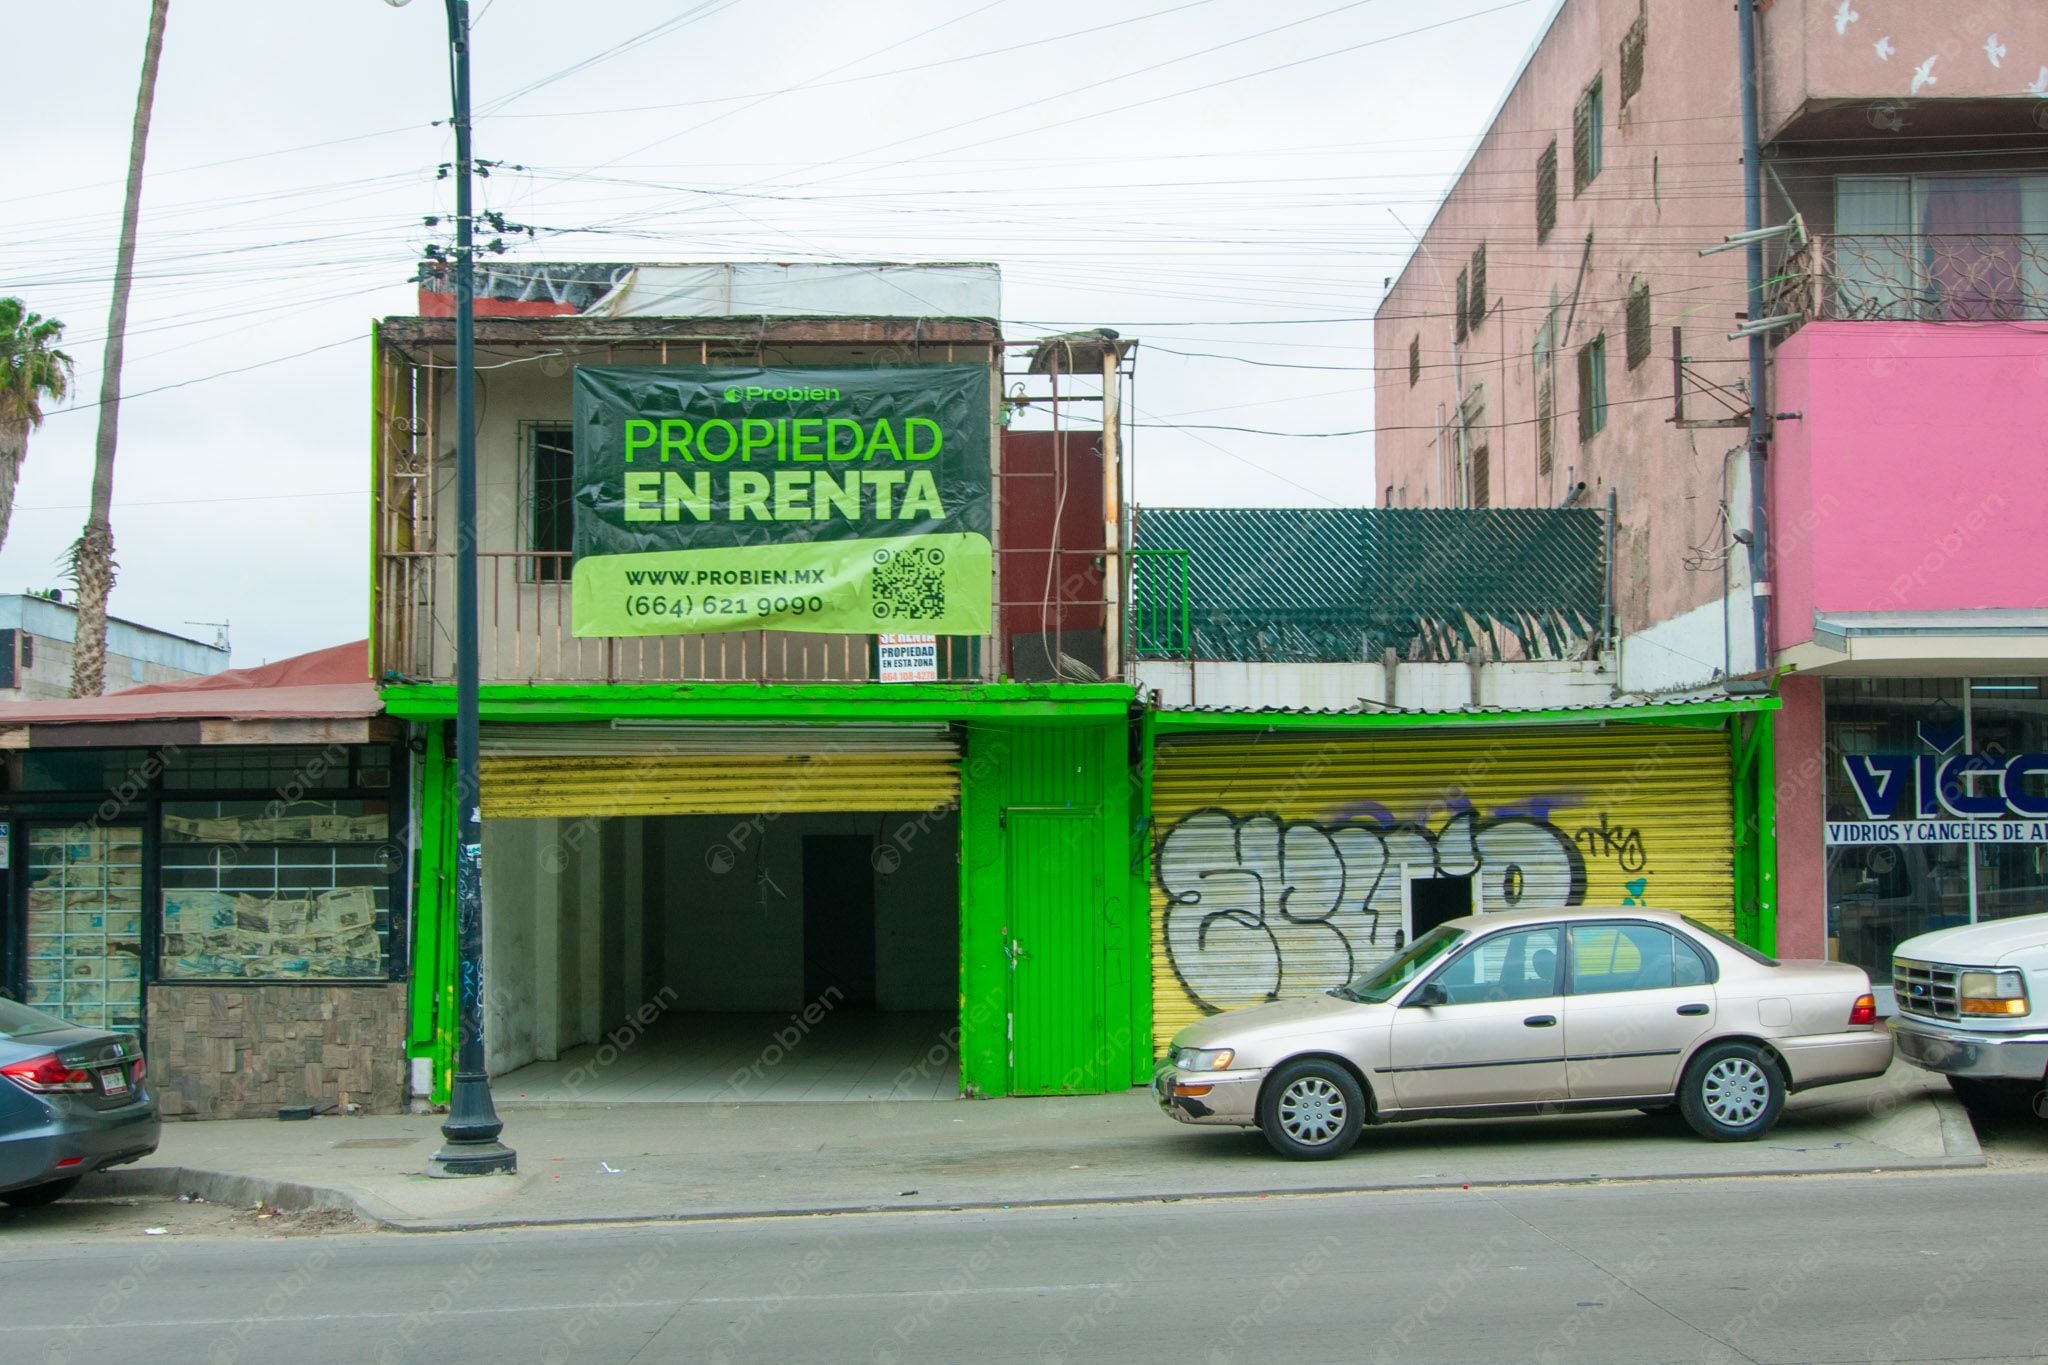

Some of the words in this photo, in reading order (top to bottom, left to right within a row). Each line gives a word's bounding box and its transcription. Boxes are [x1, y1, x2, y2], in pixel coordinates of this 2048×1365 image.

[745, 386, 840, 401] Probien
[624, 418, 943, 463] PROPIEDAD
[624, 471, 710, 521] EN
[729, 470, 946, 521] RENTA
[625, 569, 825, 586] WWW.PROBIEN.MX
[626, 595, 693, 618] (664)
[702, 595, 748, 615] 621
[757, 596, 823, 617] 9090
[881, 646, 935, 658] PROPIEDAD
[883, 659, 892, 668] EN
[894, 659, 912, 668] ESTA
[913, 658, 934, 667] ZONA
[1828, 824, 1899, 842] VIDRIOS
[1903, 824, 1914, 841] Y
[1917, 823, 1997, 841] CANCELES
[2003, 823, 2025, 841] DE
